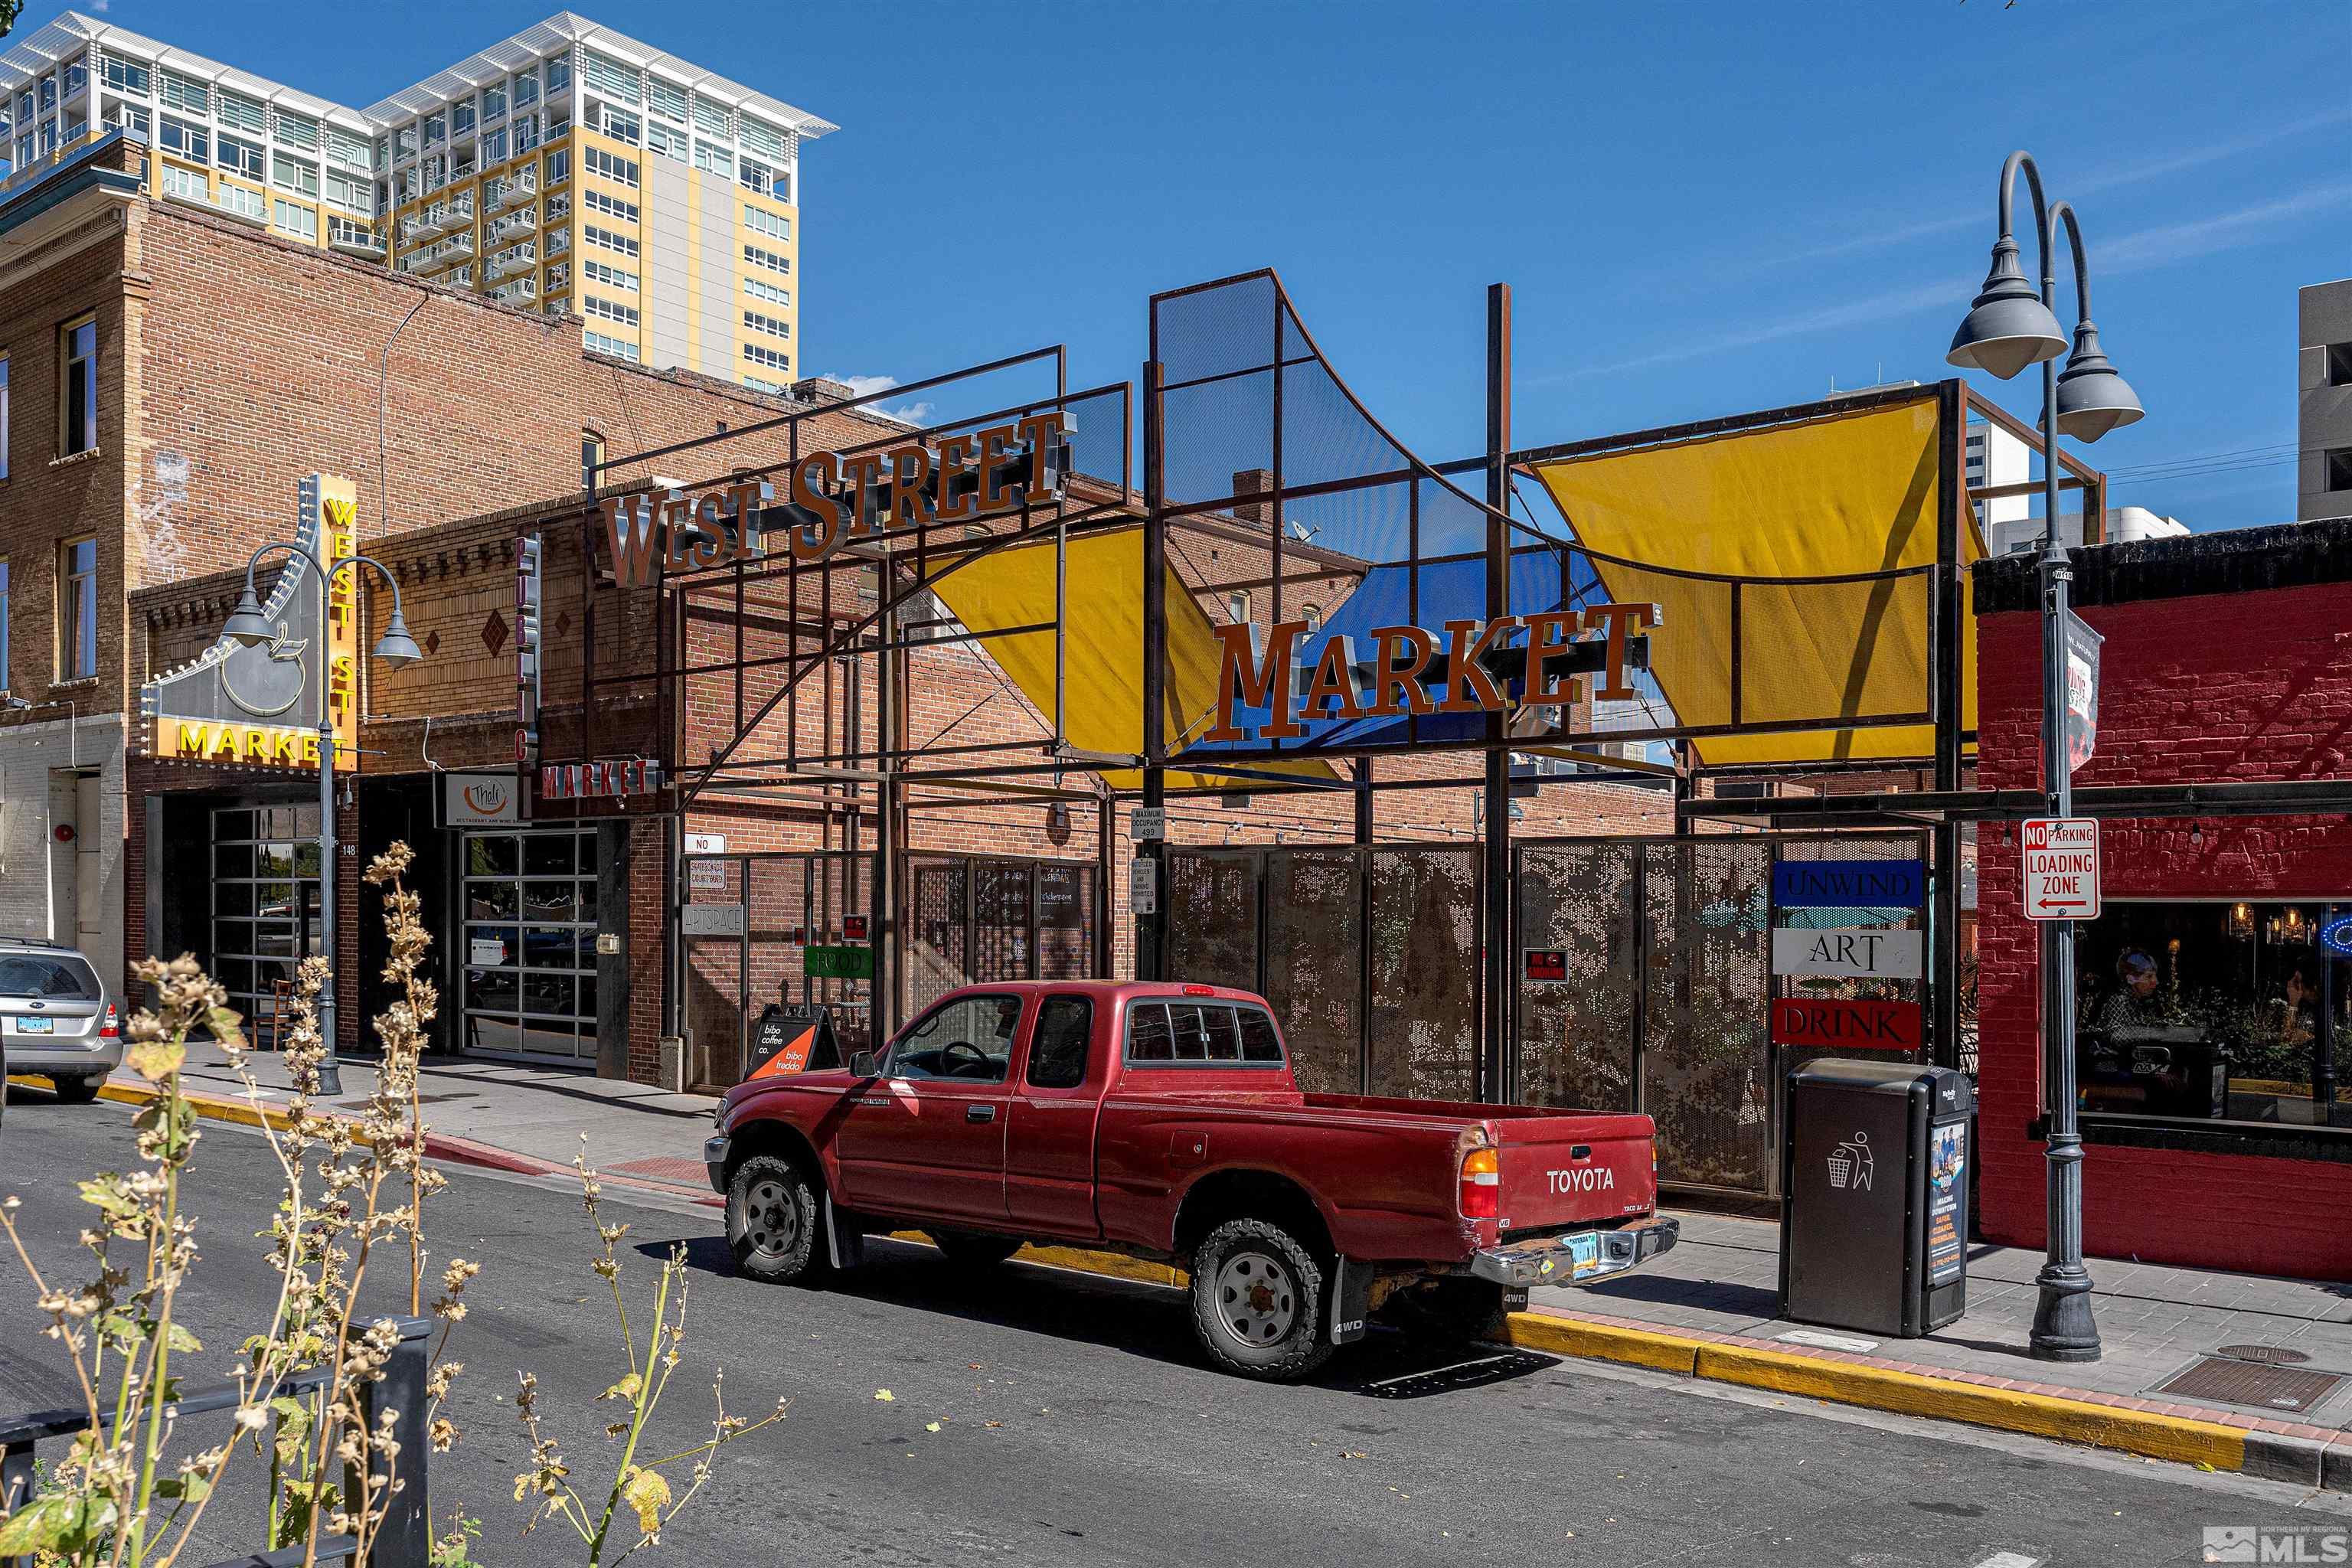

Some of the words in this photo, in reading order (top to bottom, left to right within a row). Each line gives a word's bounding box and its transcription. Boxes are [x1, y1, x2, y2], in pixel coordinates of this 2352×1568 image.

[599, 481, 774, 590] WEST
[792, 412, 1077, 560] STREET
[328, 498, 357, 629] WEST
[515, 536, 537, 761] PUBLIC
[1203, 603, 1663, 742] MARKET
[332, 656, 355, 714] ST
[181, 724, 347, 763] MARKET
[542, 760, 658, 799] MARKET
[471, 783, 500, 805] Thali
[1132, 818, 1164, 827] OCCUPANCY
[696, 839, 708, 850] NO
[2026, 827, 2046, 845] NO
[2048, 828, 2092, 841] PARKING
[342, 844, 356, 856] 148
[2030, 854, 2092, 873] LOADING
[1788, 869, 1911, 896] UNWIND
[2043, 876, 2080, 894] ZONE
[685, 909, 742, 931] ARTSPACE
[1531, 953, 1544, 965] NO
[1808, 934, 1883, 971] ART
[817, 952, 862, 975] FOOD
[1527, 967, 1564, 980] SMOKING
[764, 1024, 781, 1034] bibo
[1785, 1006, 1911, 1043] DRINK
[761, 1036, 783, 1044] coffee
[776, 1060, 800, 1070] freddo
[786, 1051, 803, 1060] bibo
[1547, 1168, 1614, 1194] TOYOTA
[1504, 1294, 1526, 1303] 4WD
[1334, 1320, 1363, 1334] 4WD
